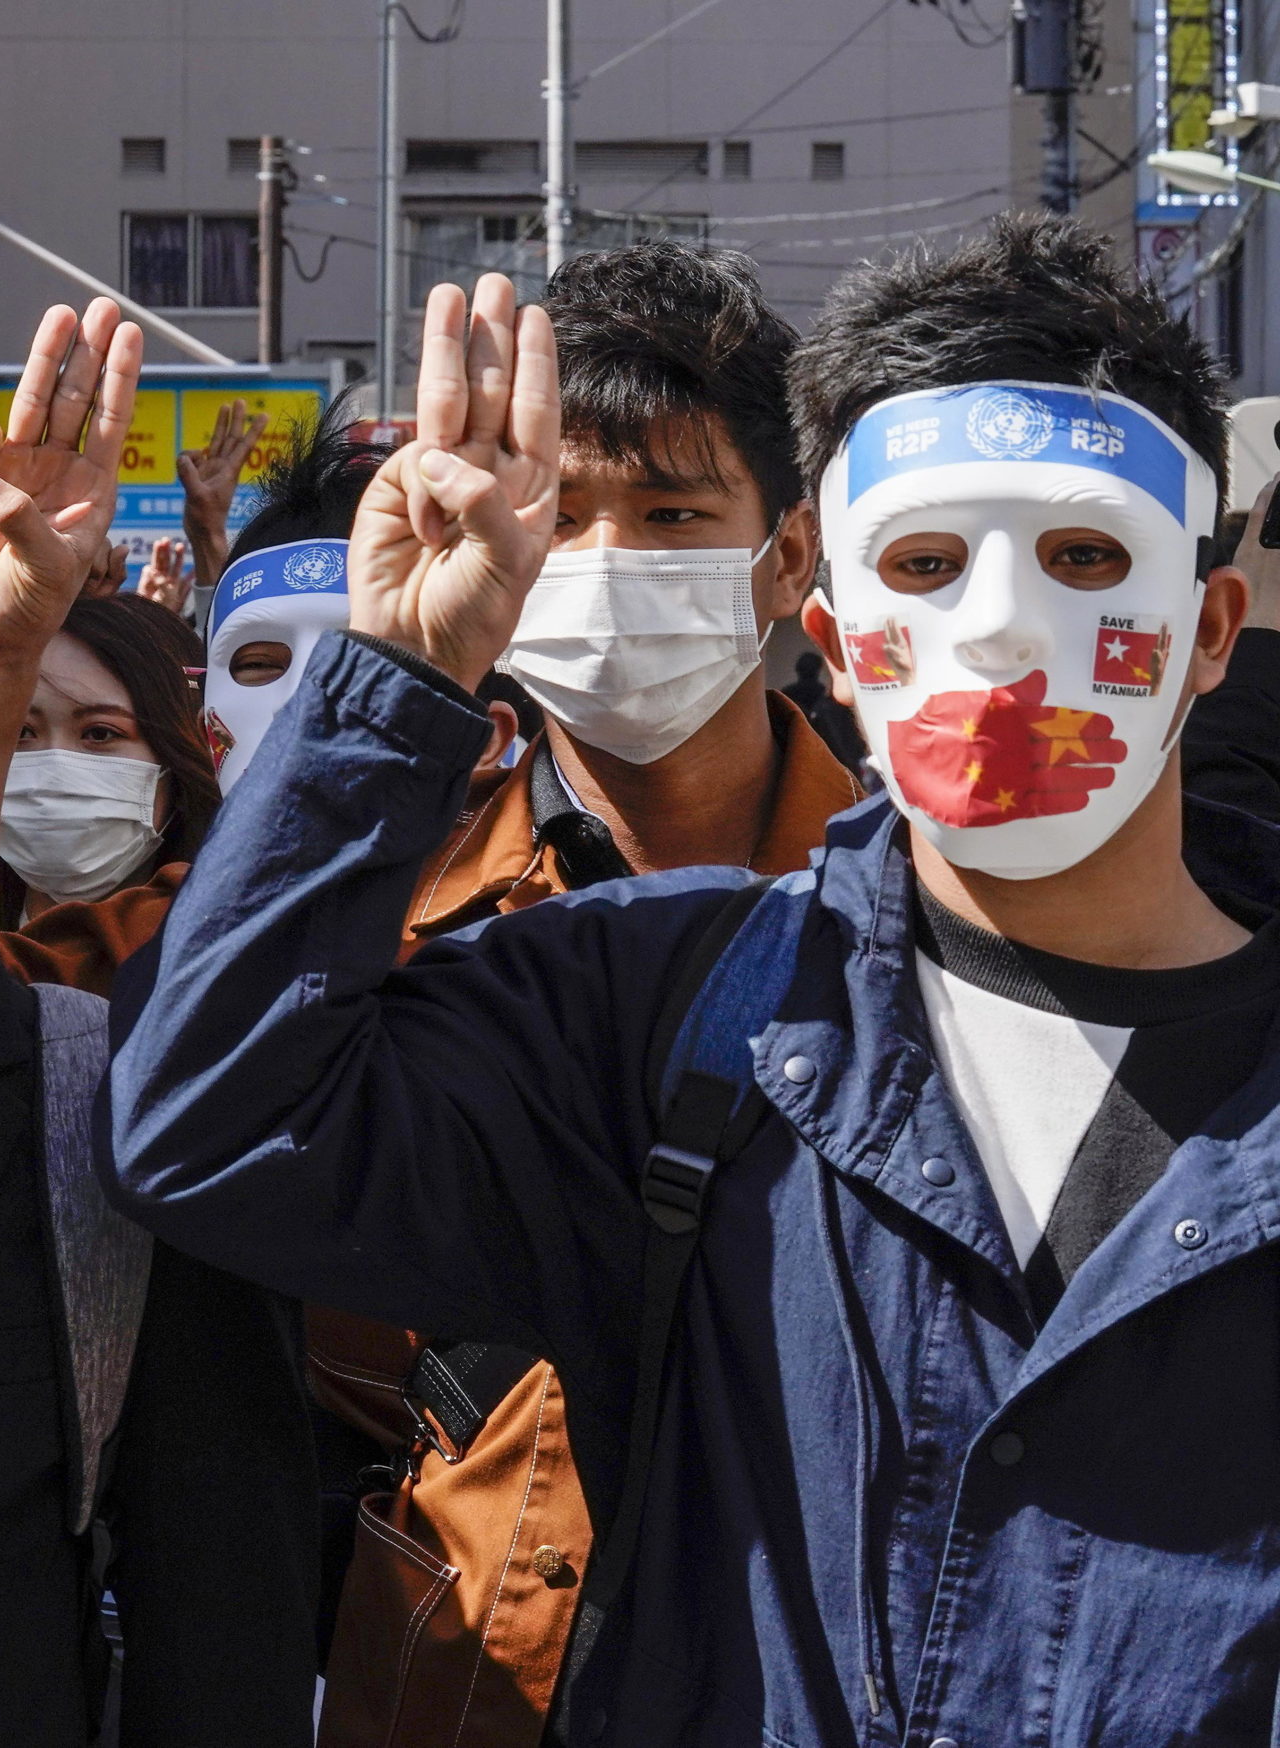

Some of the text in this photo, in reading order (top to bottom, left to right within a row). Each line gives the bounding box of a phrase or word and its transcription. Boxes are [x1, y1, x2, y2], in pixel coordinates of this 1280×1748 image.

[905, 416, 940, 432] NEED
[1071, 417, 1090, 429] WE
[886, 430, 940, 461] R2P
[1071, 429, 1126, 458] R2P
[243, 569, 264, 581] NEED
[233, 577, 263, 600] R2P
[1100, 615, 1135, 630] SAVE
[1092, 683, 1148, 697] MYANMAR
